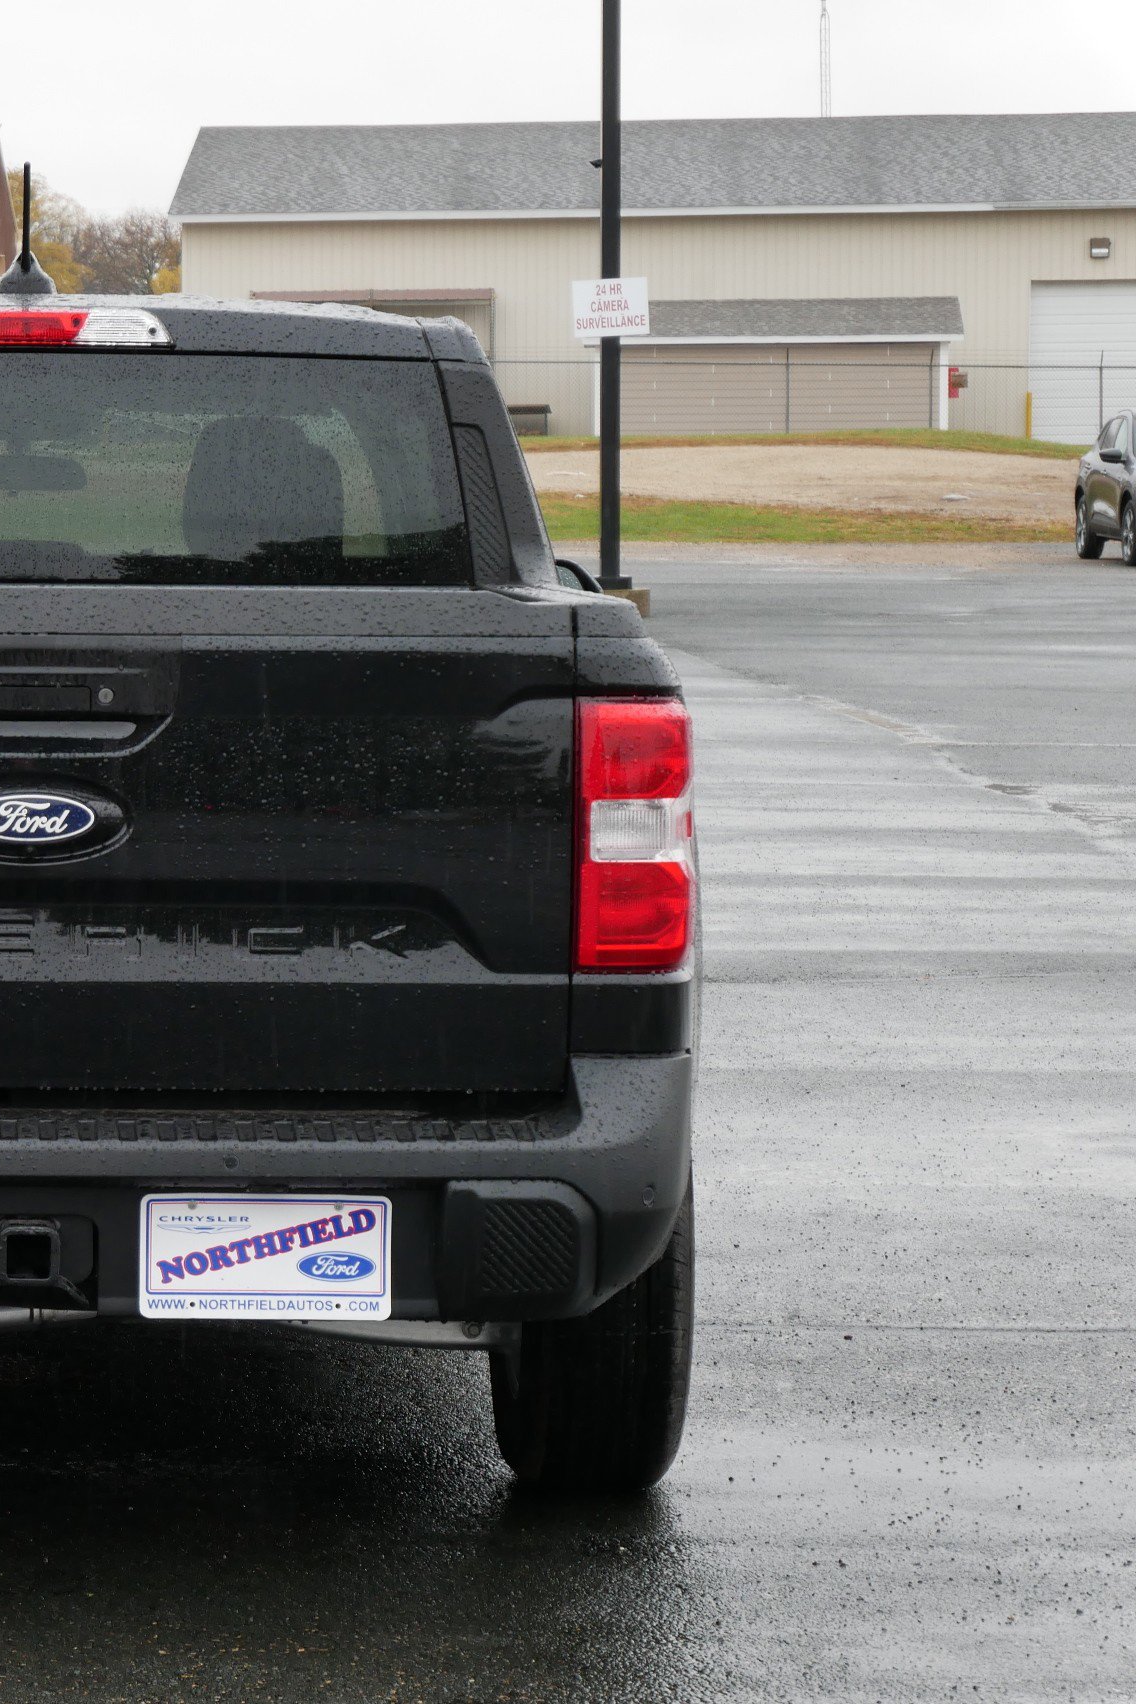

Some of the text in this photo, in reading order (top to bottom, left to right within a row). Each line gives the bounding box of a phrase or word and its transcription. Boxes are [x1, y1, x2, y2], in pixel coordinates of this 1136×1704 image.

[596, 283, 622, 296] 24 HR
[590, 300, 629, 313] CAMERA
[576, 315, 646, 330] SURVEILLANCE
[159, 1215, 250, 1223] CHRYSLER
[156, 1208, 377, 1284] NORTHFIELD
[312, 1255, 360, 1277] Ford
